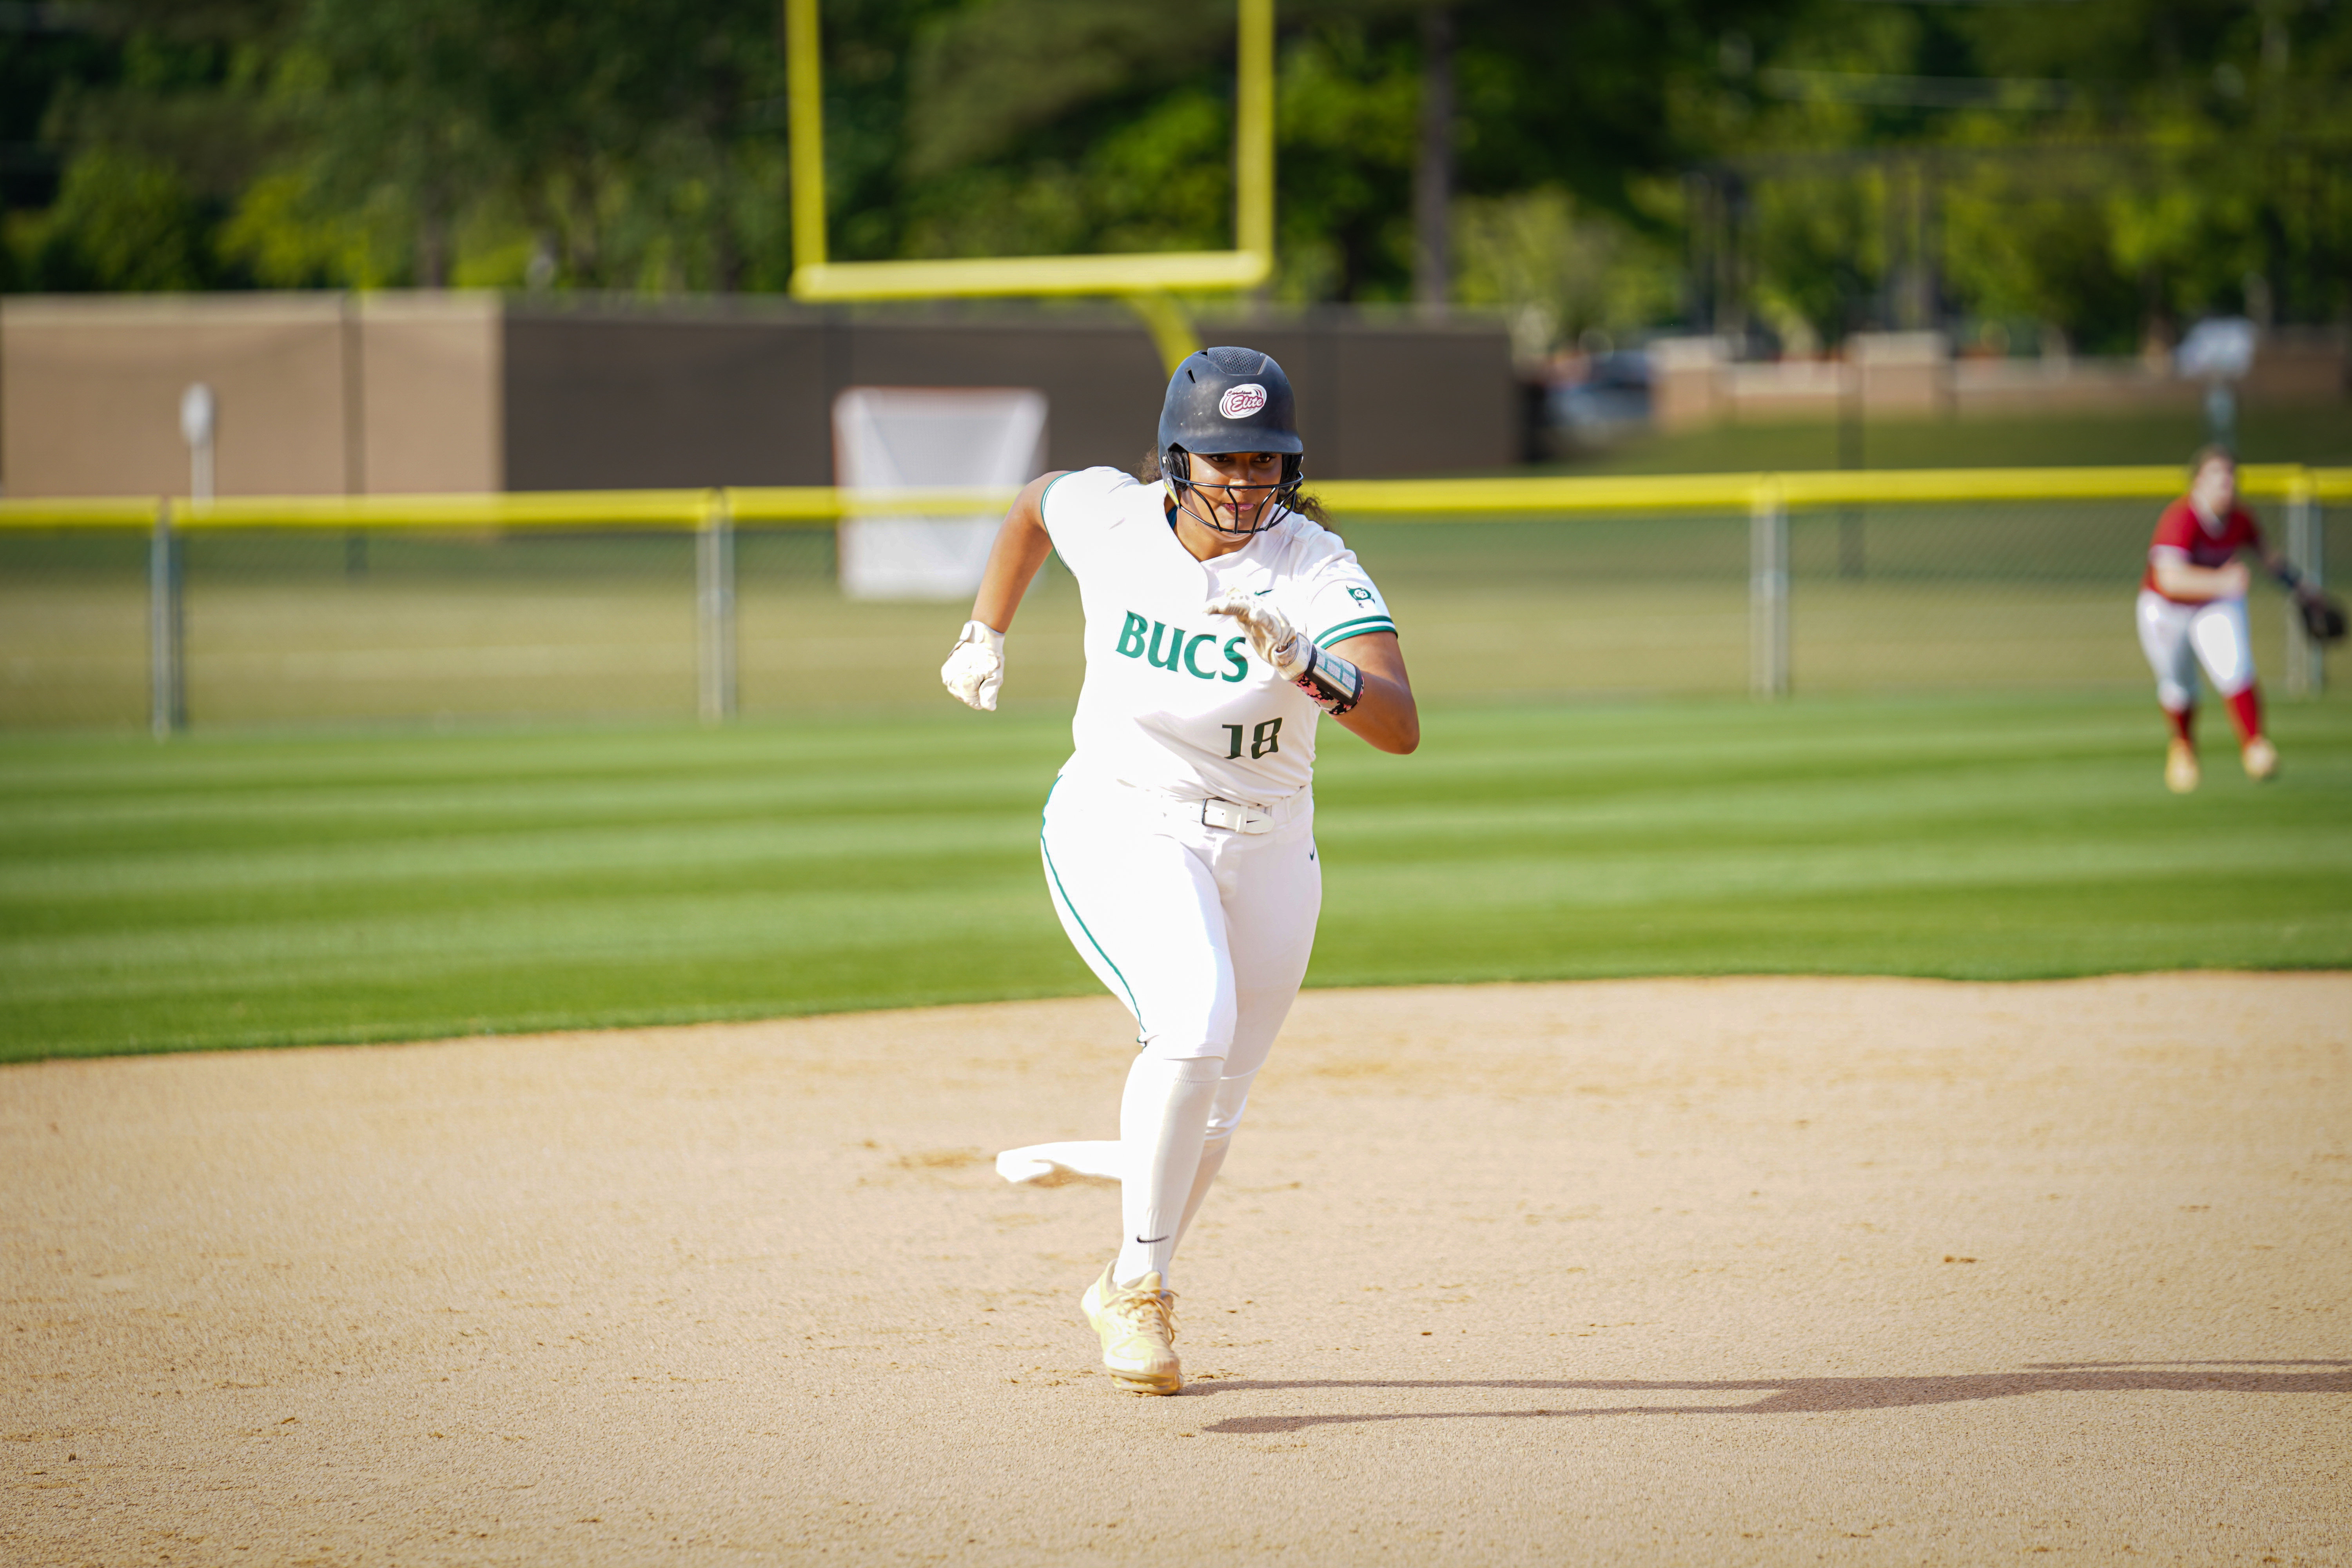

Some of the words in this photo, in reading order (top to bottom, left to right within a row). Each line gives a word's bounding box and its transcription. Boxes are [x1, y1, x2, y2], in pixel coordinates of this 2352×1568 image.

[1231, 395, 1263, 412] Elite
[1115, 610, 1249, 682] BUCS
[1222, 717, 1282, 759] 18
